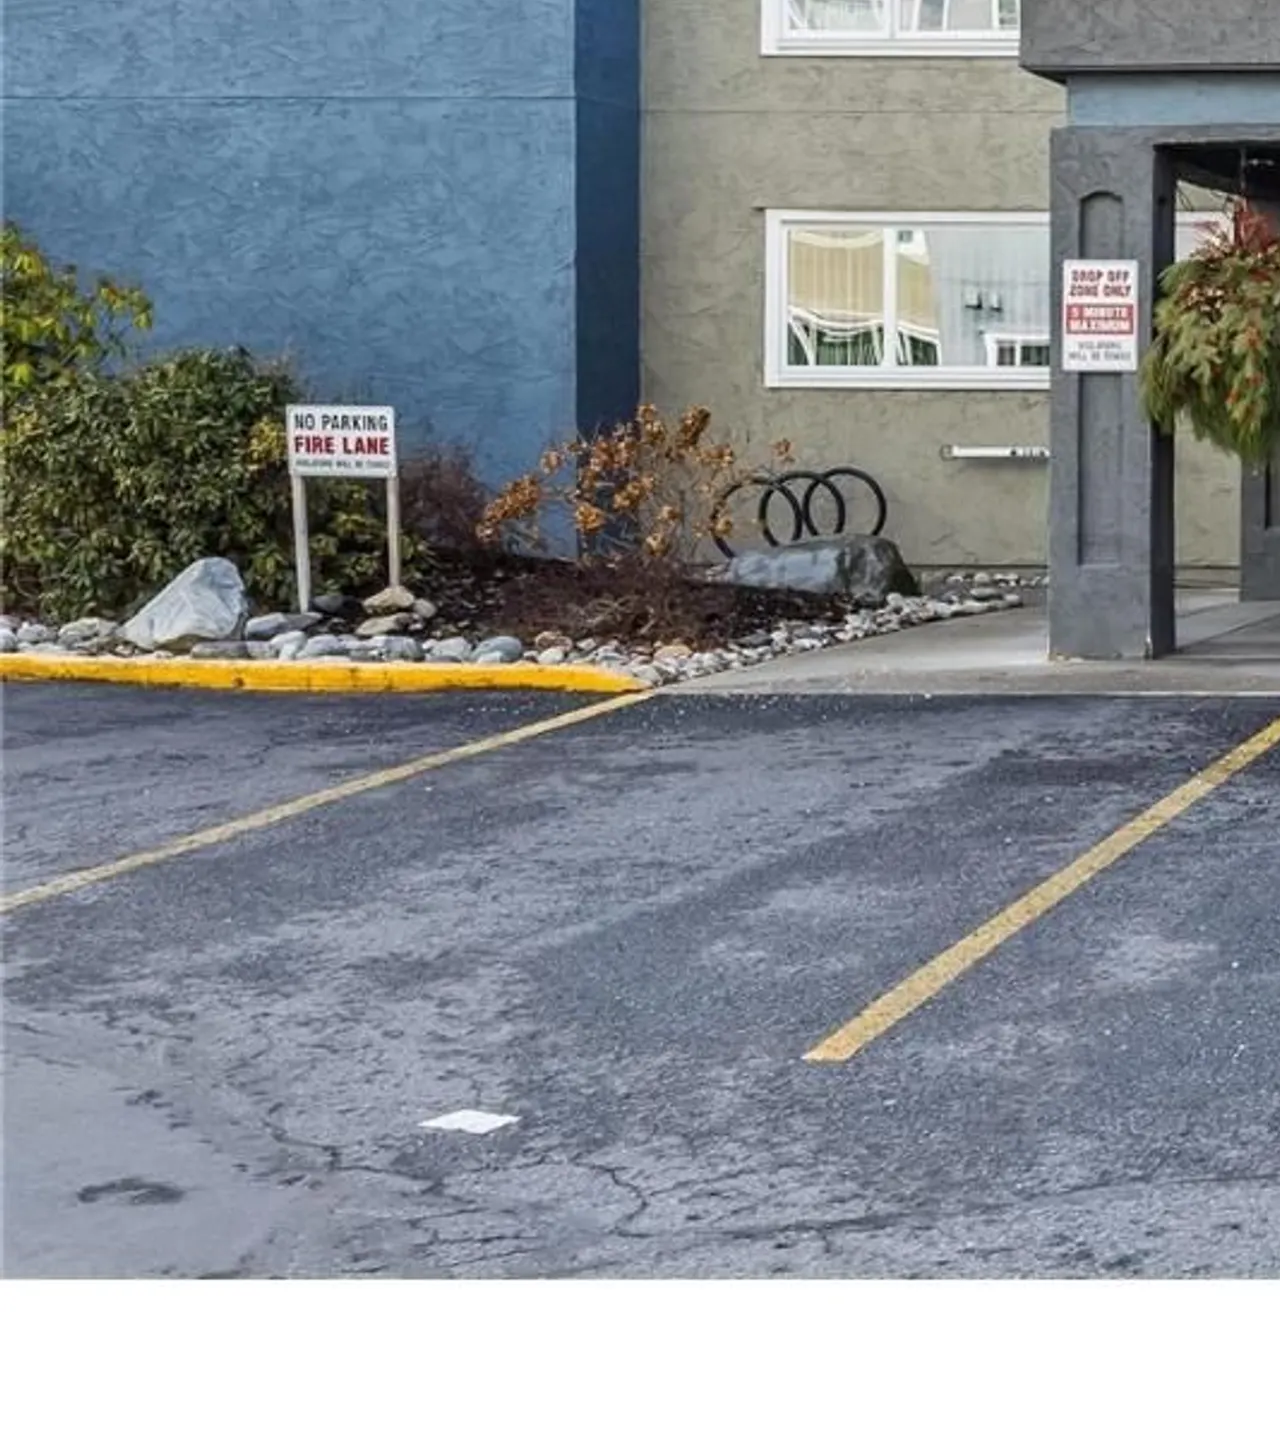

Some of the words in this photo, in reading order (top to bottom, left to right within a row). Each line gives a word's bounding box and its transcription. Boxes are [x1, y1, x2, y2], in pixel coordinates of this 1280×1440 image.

[1071, 269, 1104, 282] DROP
[1107, 269, 1131, 282] OFF
[1069, 284, 1099, 297] ZONE
[1103, 284, 1132, 297] ONLY
[294, 413, 316, 430] NO
[321, 414, 388, 431] PARKING
[294, 436, 335, 453] FIRE
[342, 437, 390, 455] LANE
